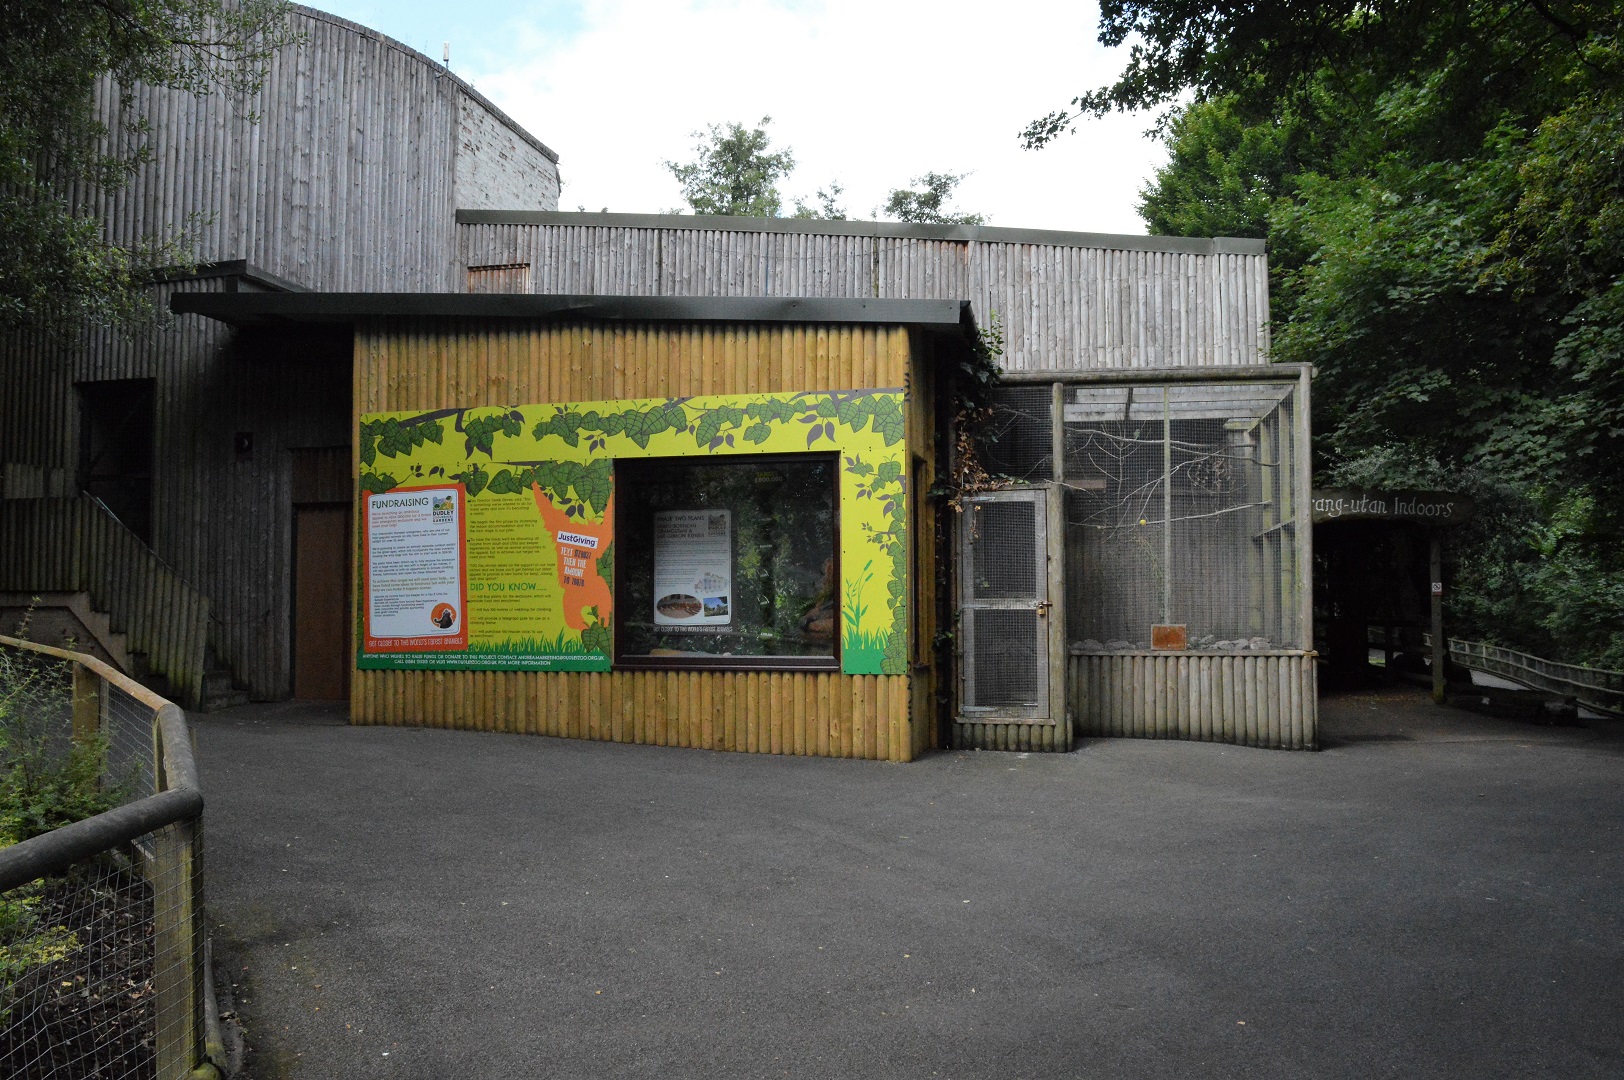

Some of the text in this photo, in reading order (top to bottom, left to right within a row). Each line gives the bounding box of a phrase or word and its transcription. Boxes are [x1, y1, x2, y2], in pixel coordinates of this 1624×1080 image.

[372, 498, 428, 508] FUNDRAISING
[1312, 494, 1454, 518] ang-utan Indoors
[558, 533, 596, 547] JustGiving
[561, 547, 573, 556] TEXT
[564, 557, 576, 566] THEN
[578, 559, 586, 568] THE
[564, 566, 584, 577] AMOUNT
[564, 576, 570, 584] TO
[470, 583, 484, 591] DID
[487, 583, 504, 591] YOU
